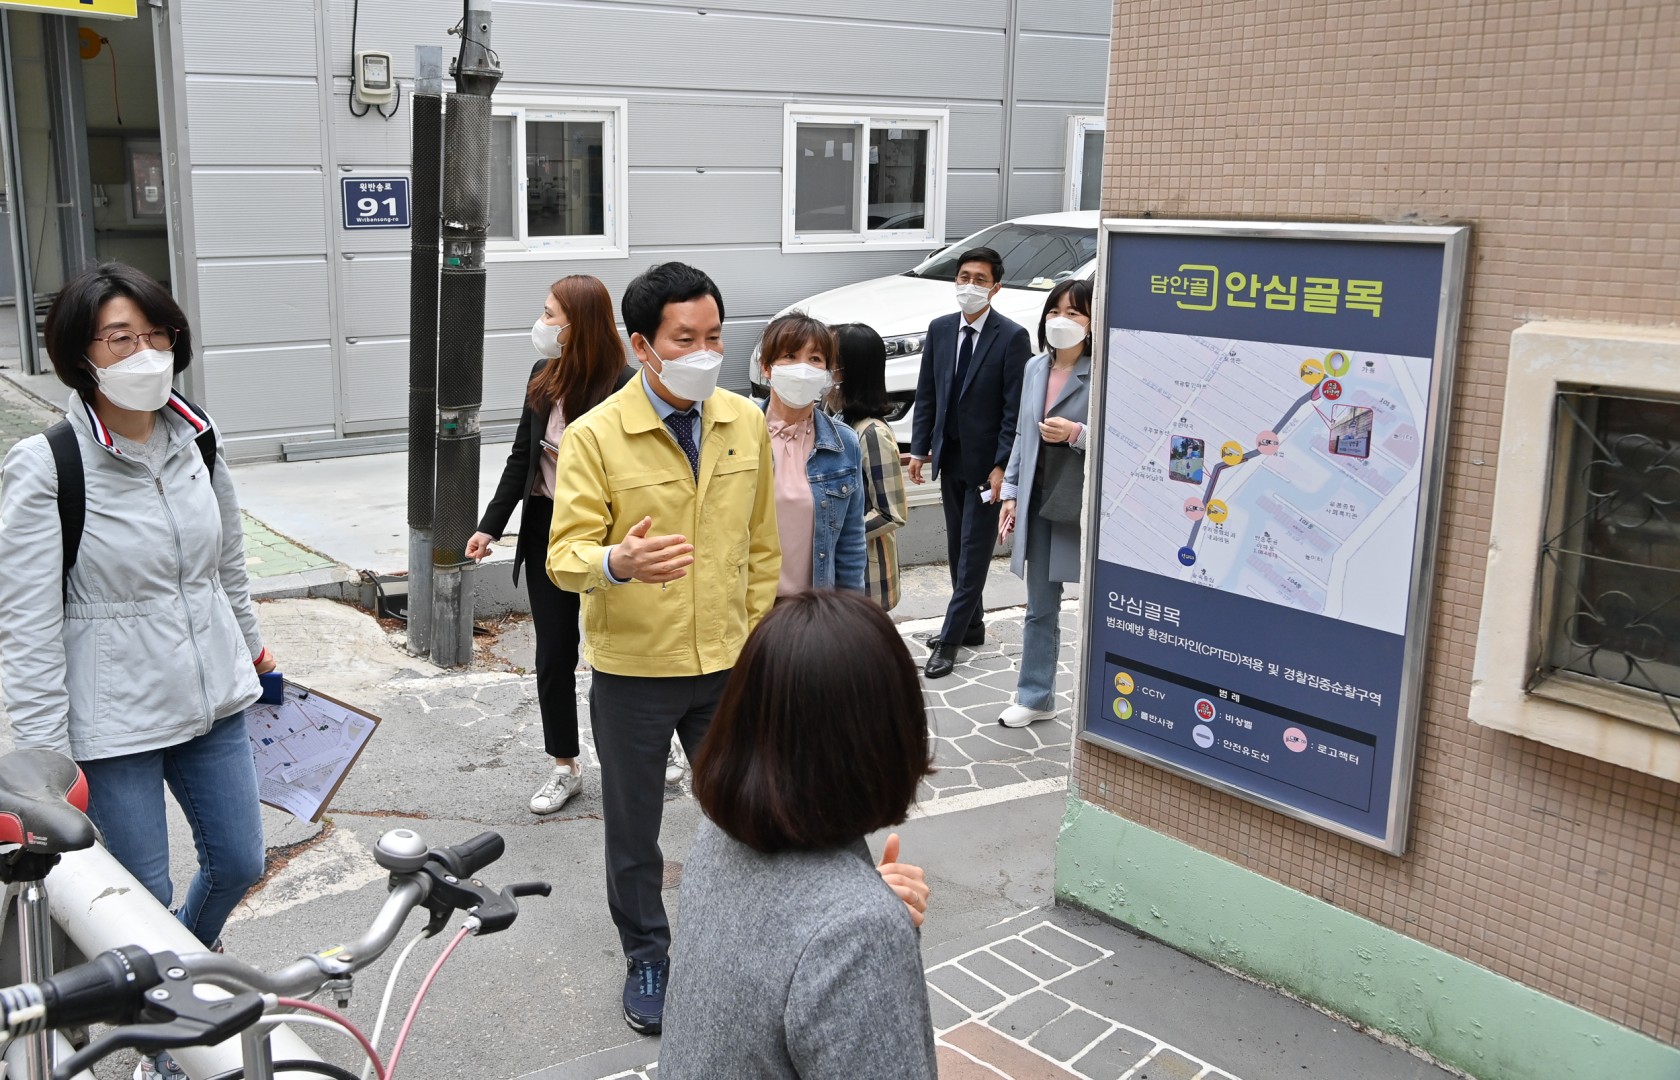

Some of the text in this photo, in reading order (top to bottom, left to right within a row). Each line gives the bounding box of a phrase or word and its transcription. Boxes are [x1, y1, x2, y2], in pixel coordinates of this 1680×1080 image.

[359, 182, 393, 193] 윗반송로
[357, 197, 397, 217] 91
[1151, 271, 1383, 318] 담안골 안심골목
[1108, 591, 1181, 628] 안심골목
[1106, 615, 1382, 707] 범죄예방 환경디자인(CPTED)적용 및 경찰집중순찰구역
[1141, 686, 1166, 700] CCTV
[1224, 712, 1253, 730] 비상벨
[1222, 738, 1270, 764] 안전유도선
[1317, 743, 1359, 766] 로고젝터
